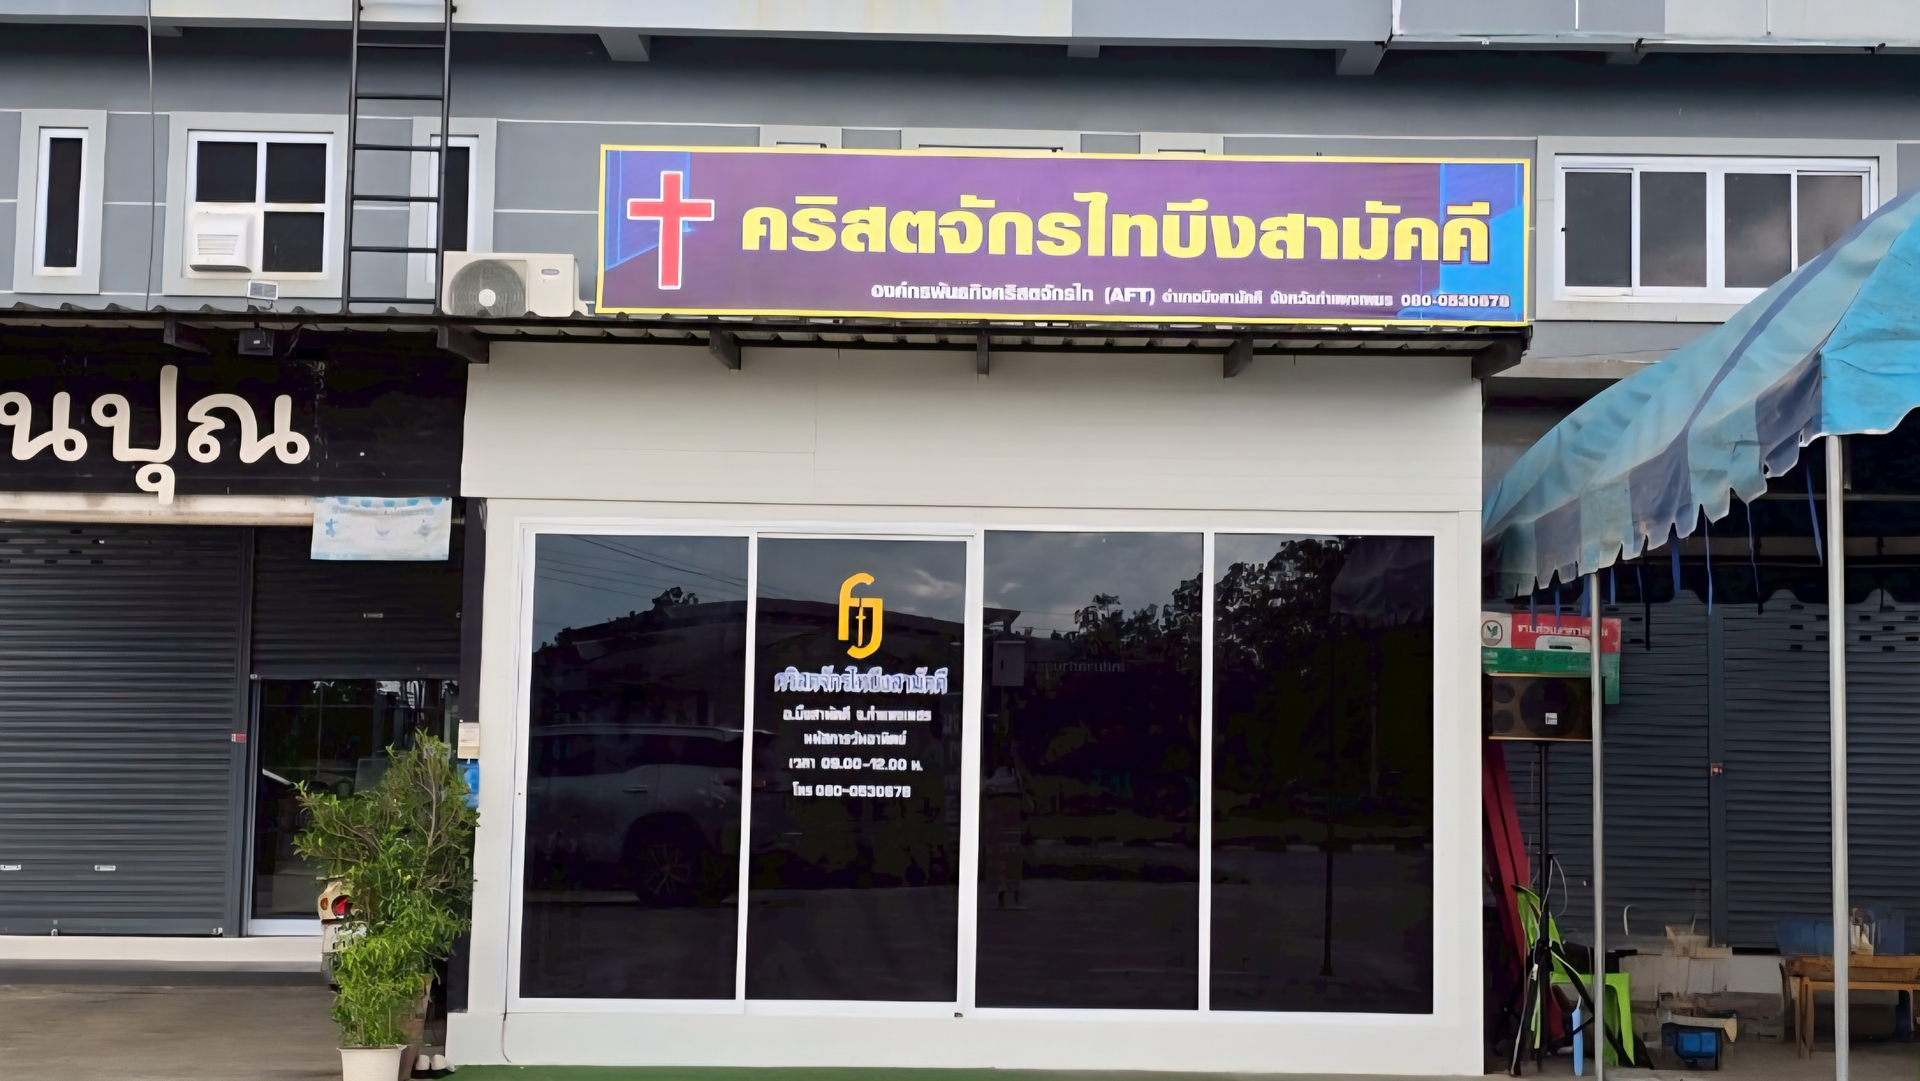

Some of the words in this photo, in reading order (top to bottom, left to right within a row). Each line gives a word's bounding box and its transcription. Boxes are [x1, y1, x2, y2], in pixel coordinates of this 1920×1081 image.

[741, 191, 1490, 264] คริสตจักรไทบึงสามัคคี
[1104, 286, 1156, 307] (AFT)
[788, 757, 816, 769] เวลา
[792, 780, 813, 796] โทร
